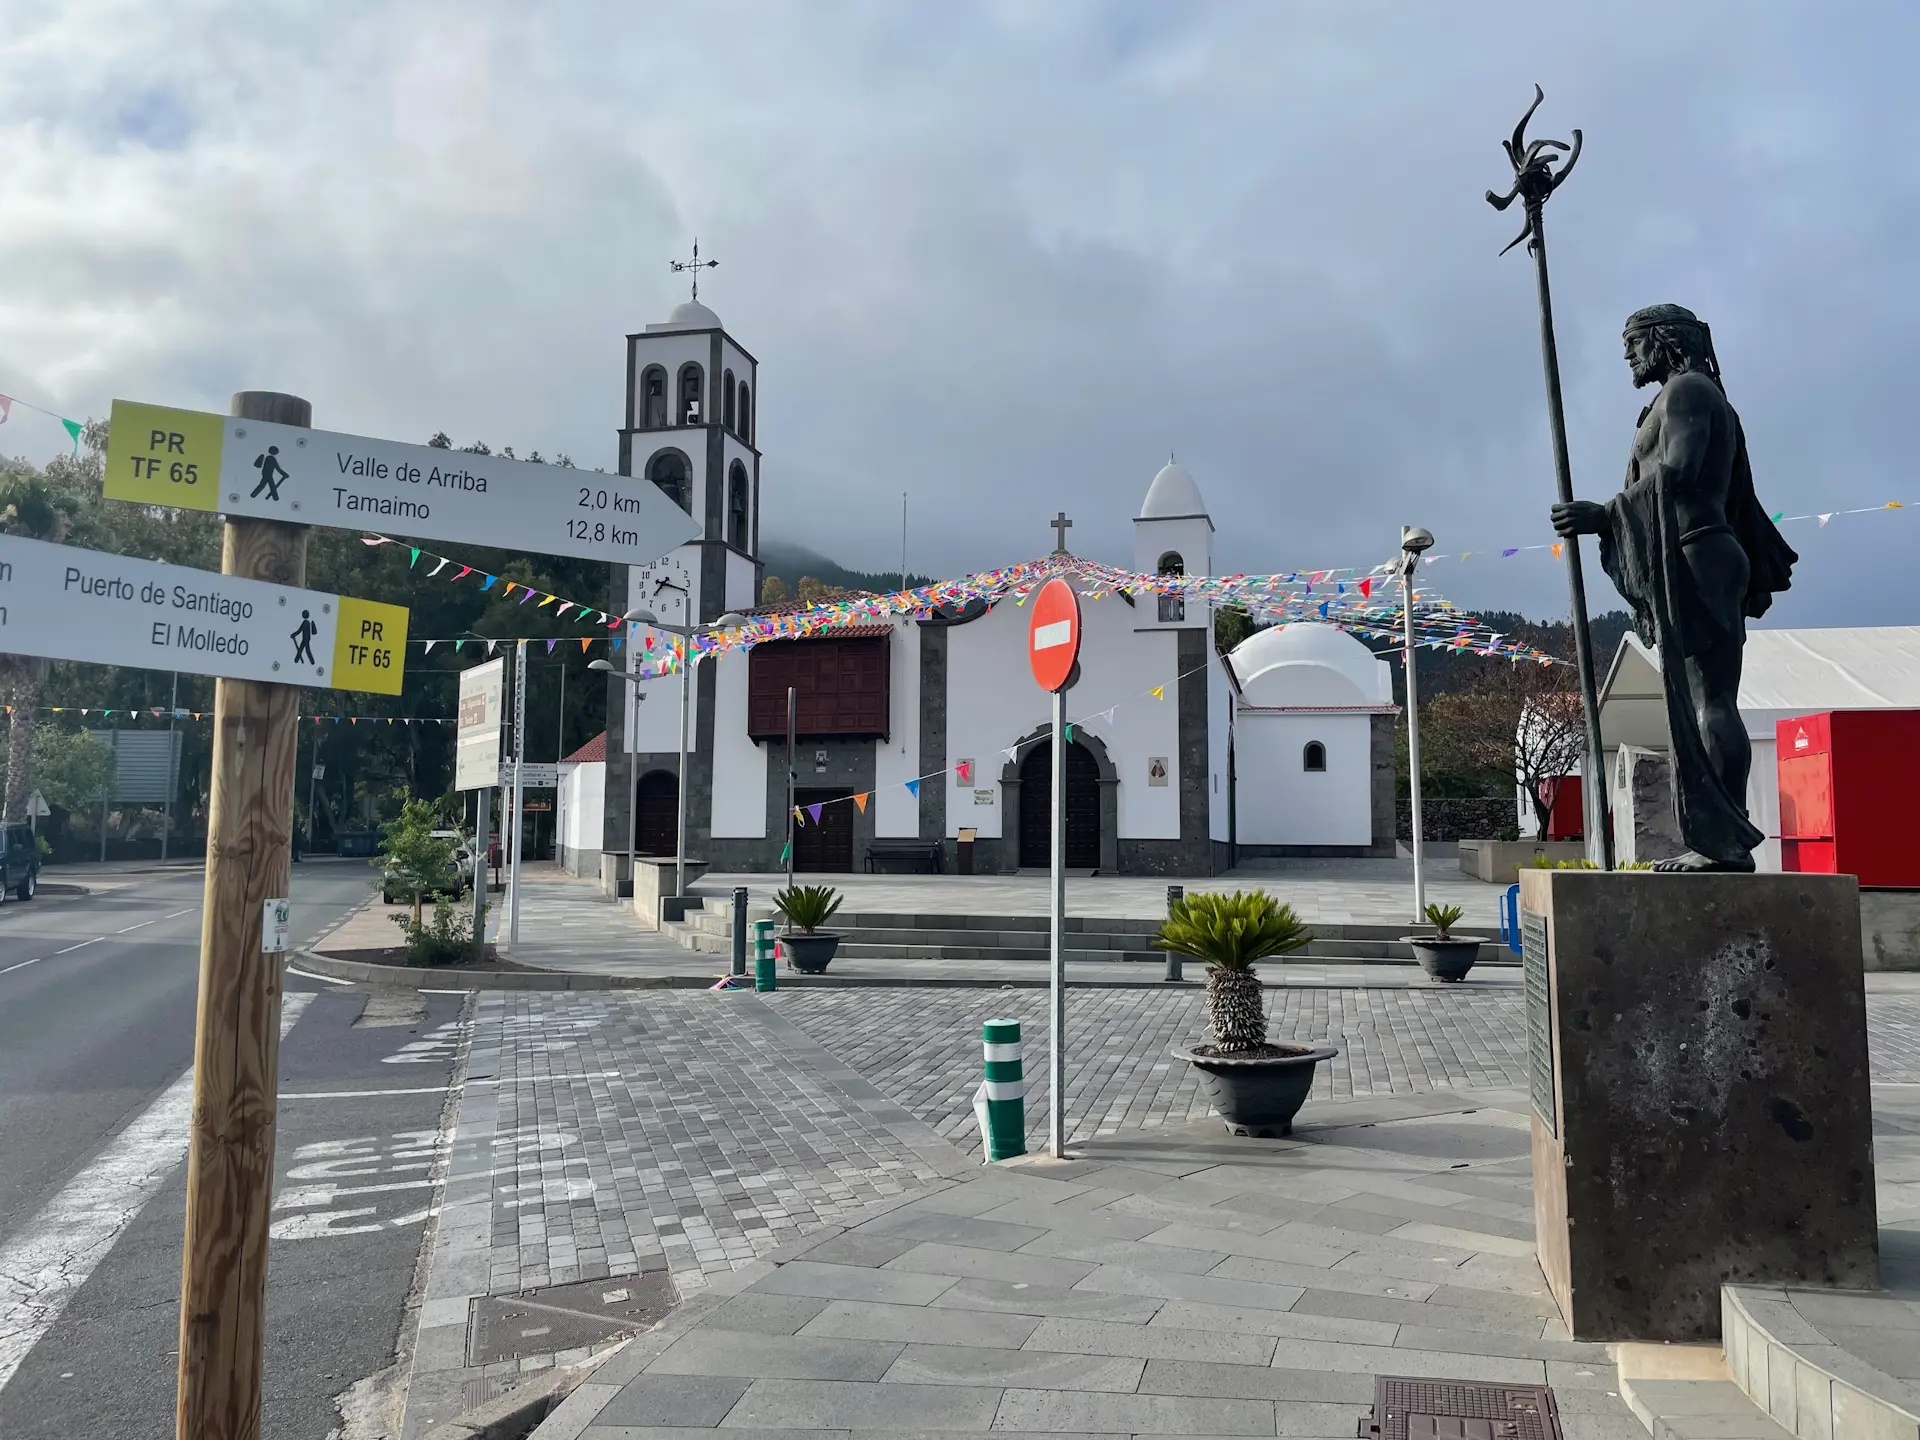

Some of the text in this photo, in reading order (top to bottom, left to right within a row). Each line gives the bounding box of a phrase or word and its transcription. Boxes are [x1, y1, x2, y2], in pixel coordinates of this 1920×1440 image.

[150, 430, 185, 455] PR
[130, 456, 198, 485] TF 65
[336, 452, 487, 493] Valle de Arriba
[332, 487, 430, 519] Tamaimo
[578, 487, 640, 514] 2,0 km
[566, 519, 638, 546] 12,8 km
[64, 566, 253, 622] Puerto de Santiago
[151, 621, 249, 656] El Molledo
[361, 619, 383, 642] PR
[348, 644, 391, 669] TF 65
